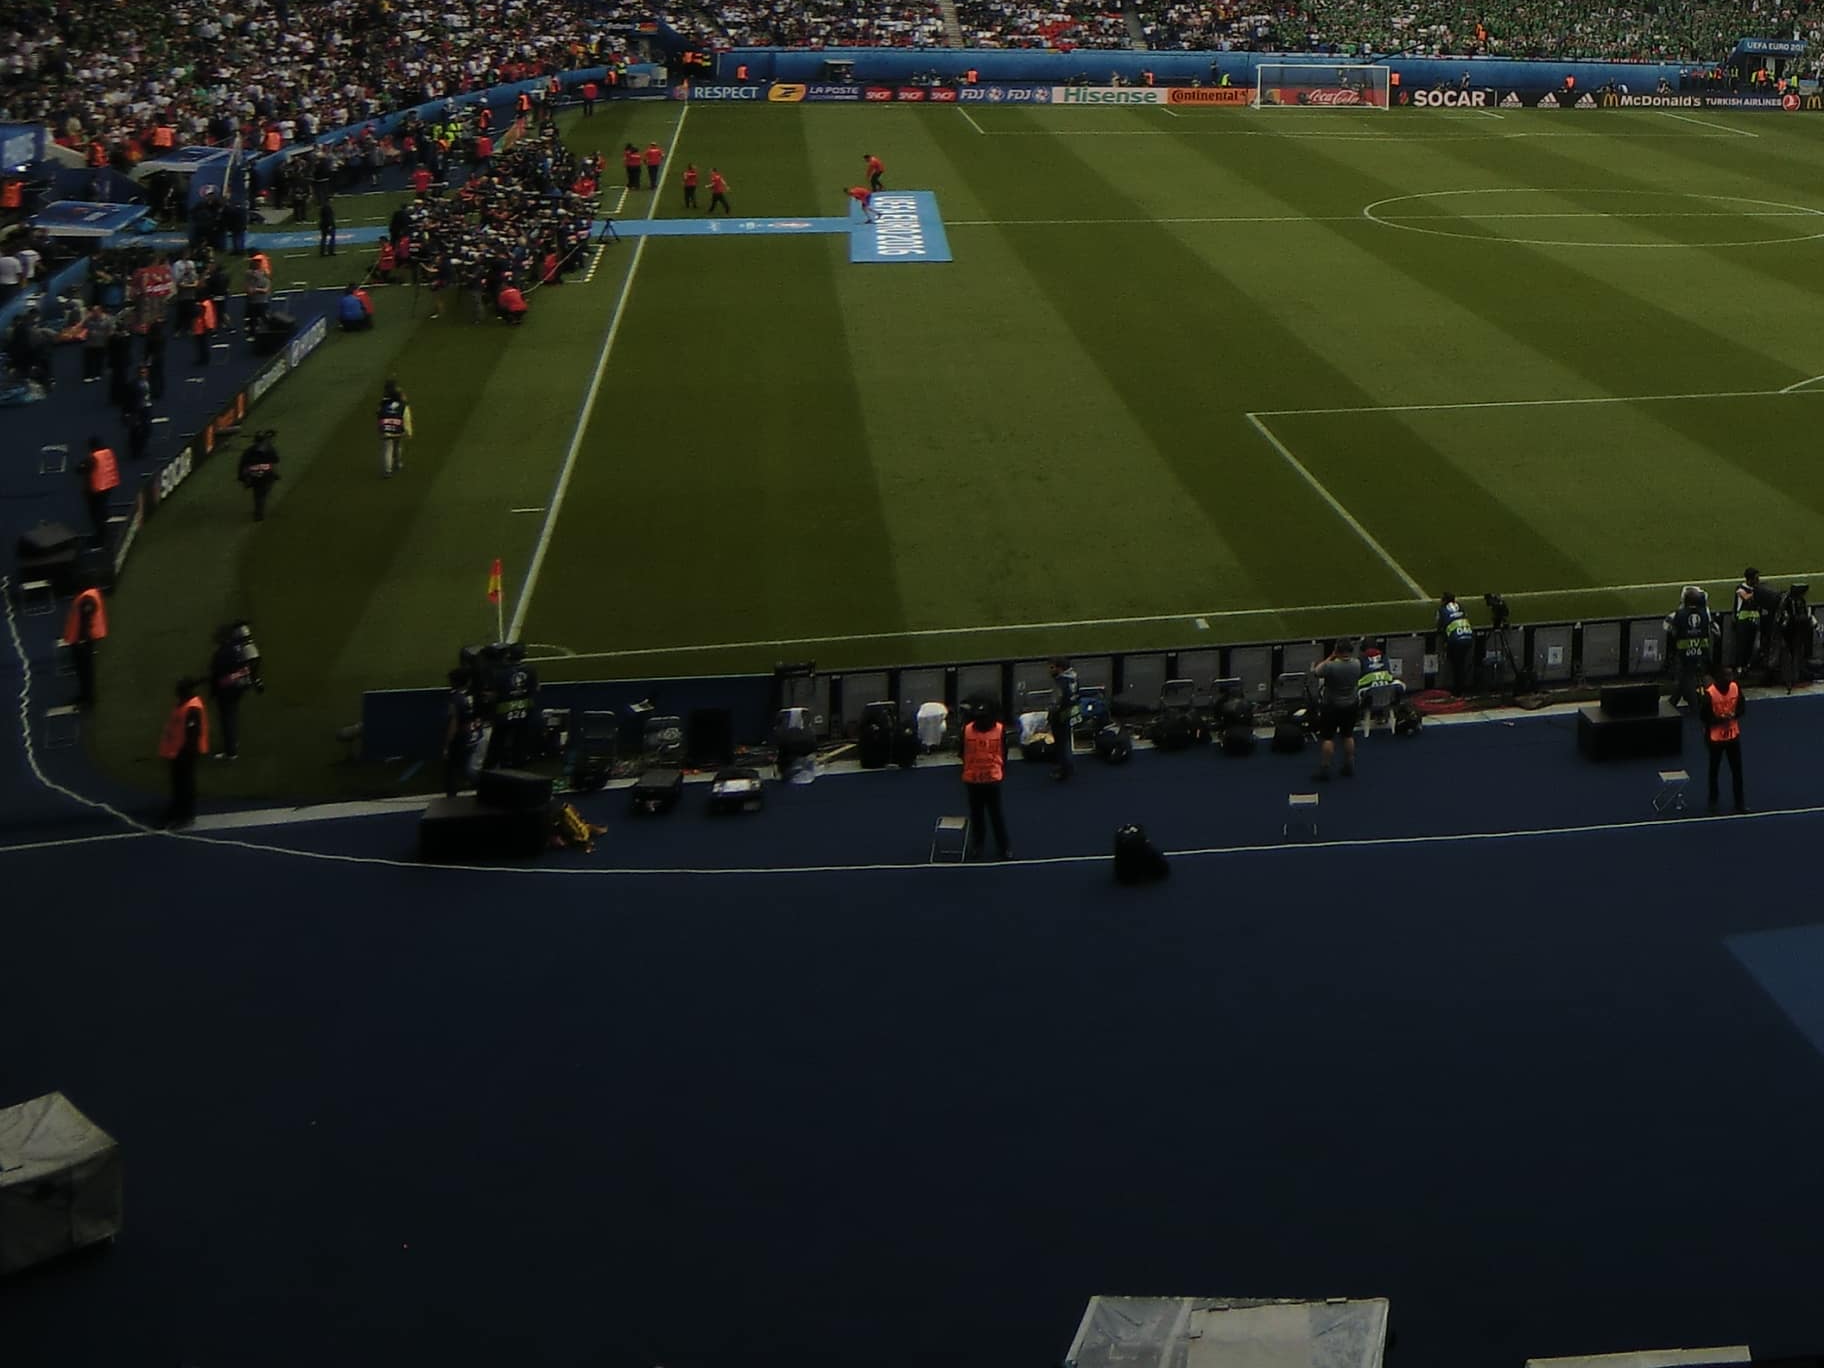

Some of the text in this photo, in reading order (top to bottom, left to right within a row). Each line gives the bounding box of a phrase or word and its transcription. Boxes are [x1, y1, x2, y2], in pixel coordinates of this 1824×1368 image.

[694, 86, 759, 100] RESPECT
[809, 86, 859, 95] LA POSTE
[1063, 88, 1157, 103] Hisense
[1171, 89, 1239, 102] Continental
[1413, 90, 1486, 107] SOCAR
[1620, 95, 1702, 108] McDonald's
[1706, 97, 1782, 107] TURKISH AIRLINES
